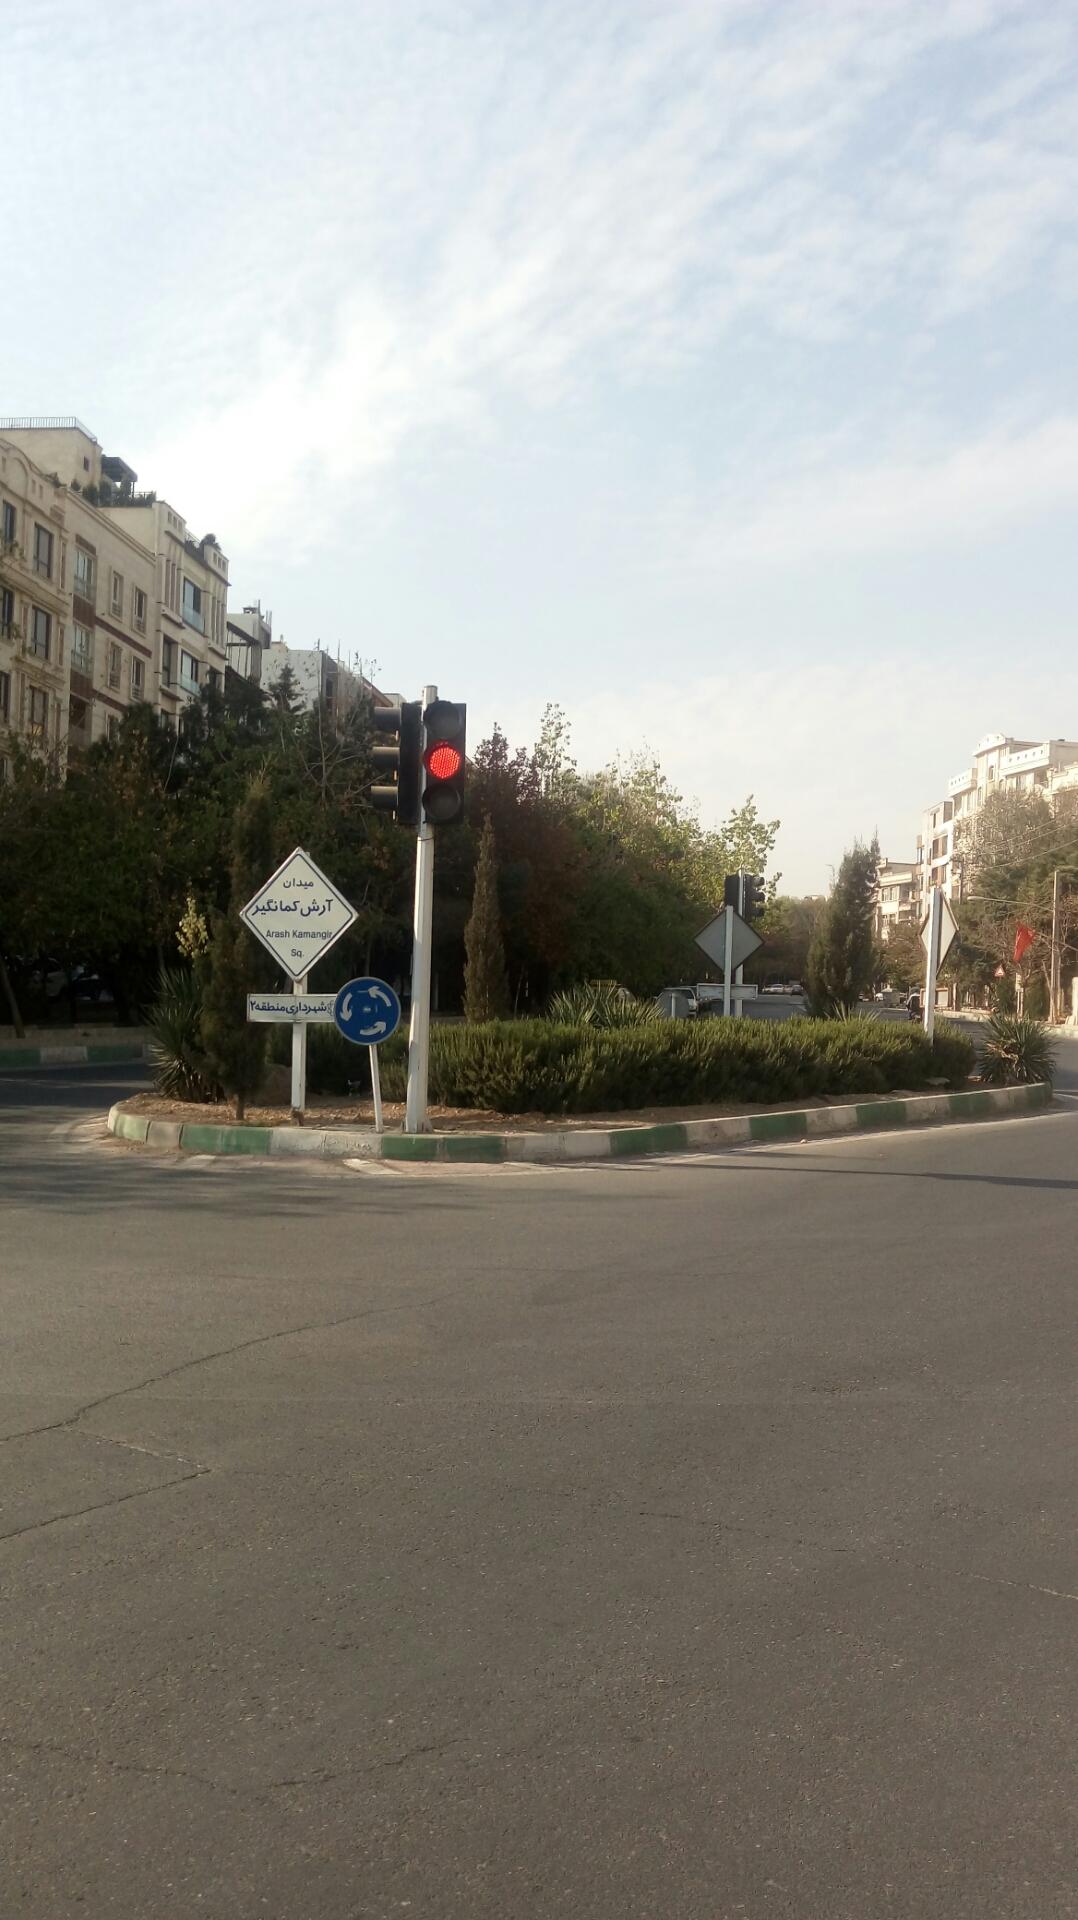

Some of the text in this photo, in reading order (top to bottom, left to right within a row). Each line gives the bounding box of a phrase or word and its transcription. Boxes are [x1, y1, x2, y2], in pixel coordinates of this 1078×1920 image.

[283, 878, 314, 890] میدان
[251, 899, 334, 917] آرش کمانگیر
[266, 929, 333, 940] Arash Kamangir
[290, 948, 304, 959] Sq.
[285, 1001, 327, 1014] شهرداری
